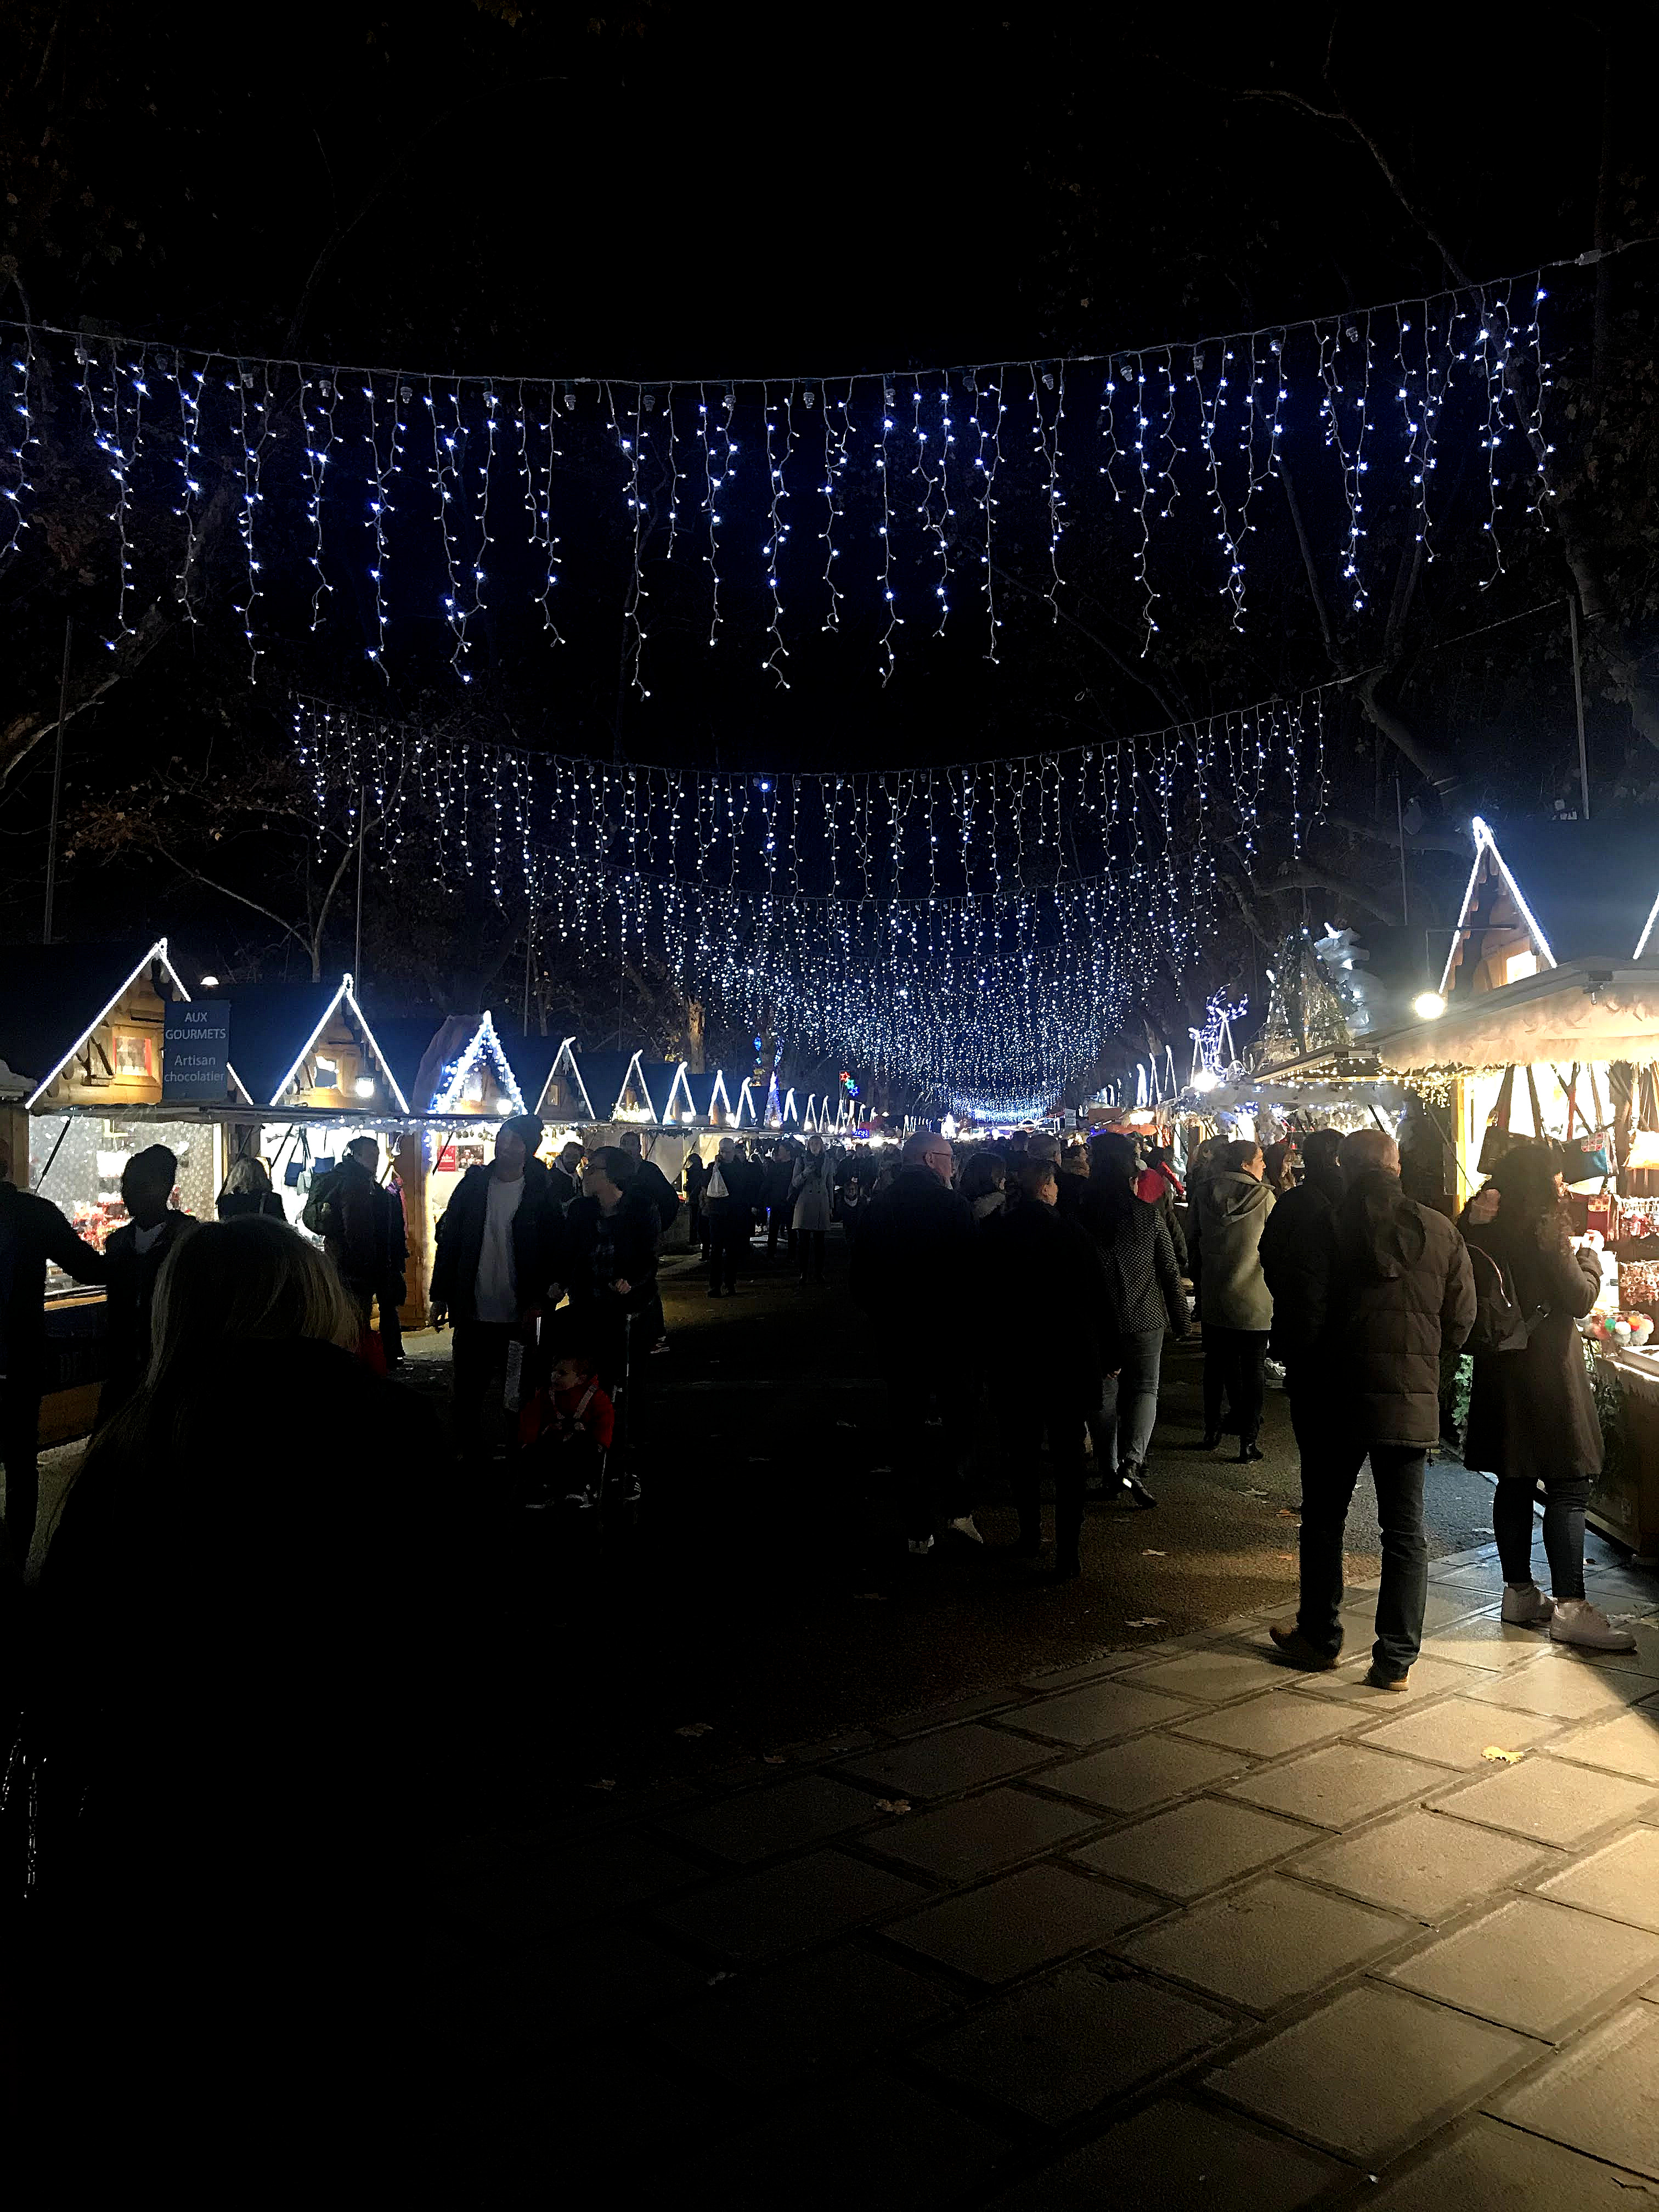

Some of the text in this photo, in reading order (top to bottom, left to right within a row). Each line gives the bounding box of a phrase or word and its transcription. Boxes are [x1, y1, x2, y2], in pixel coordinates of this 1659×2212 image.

[184, 1012, 208, 1023] AUX
[165, 1029, 226, 1040] GOURMETS
[174, 1054, 216, 1066] Artisan
[164, 1071, 224, 1082] chocolatier
